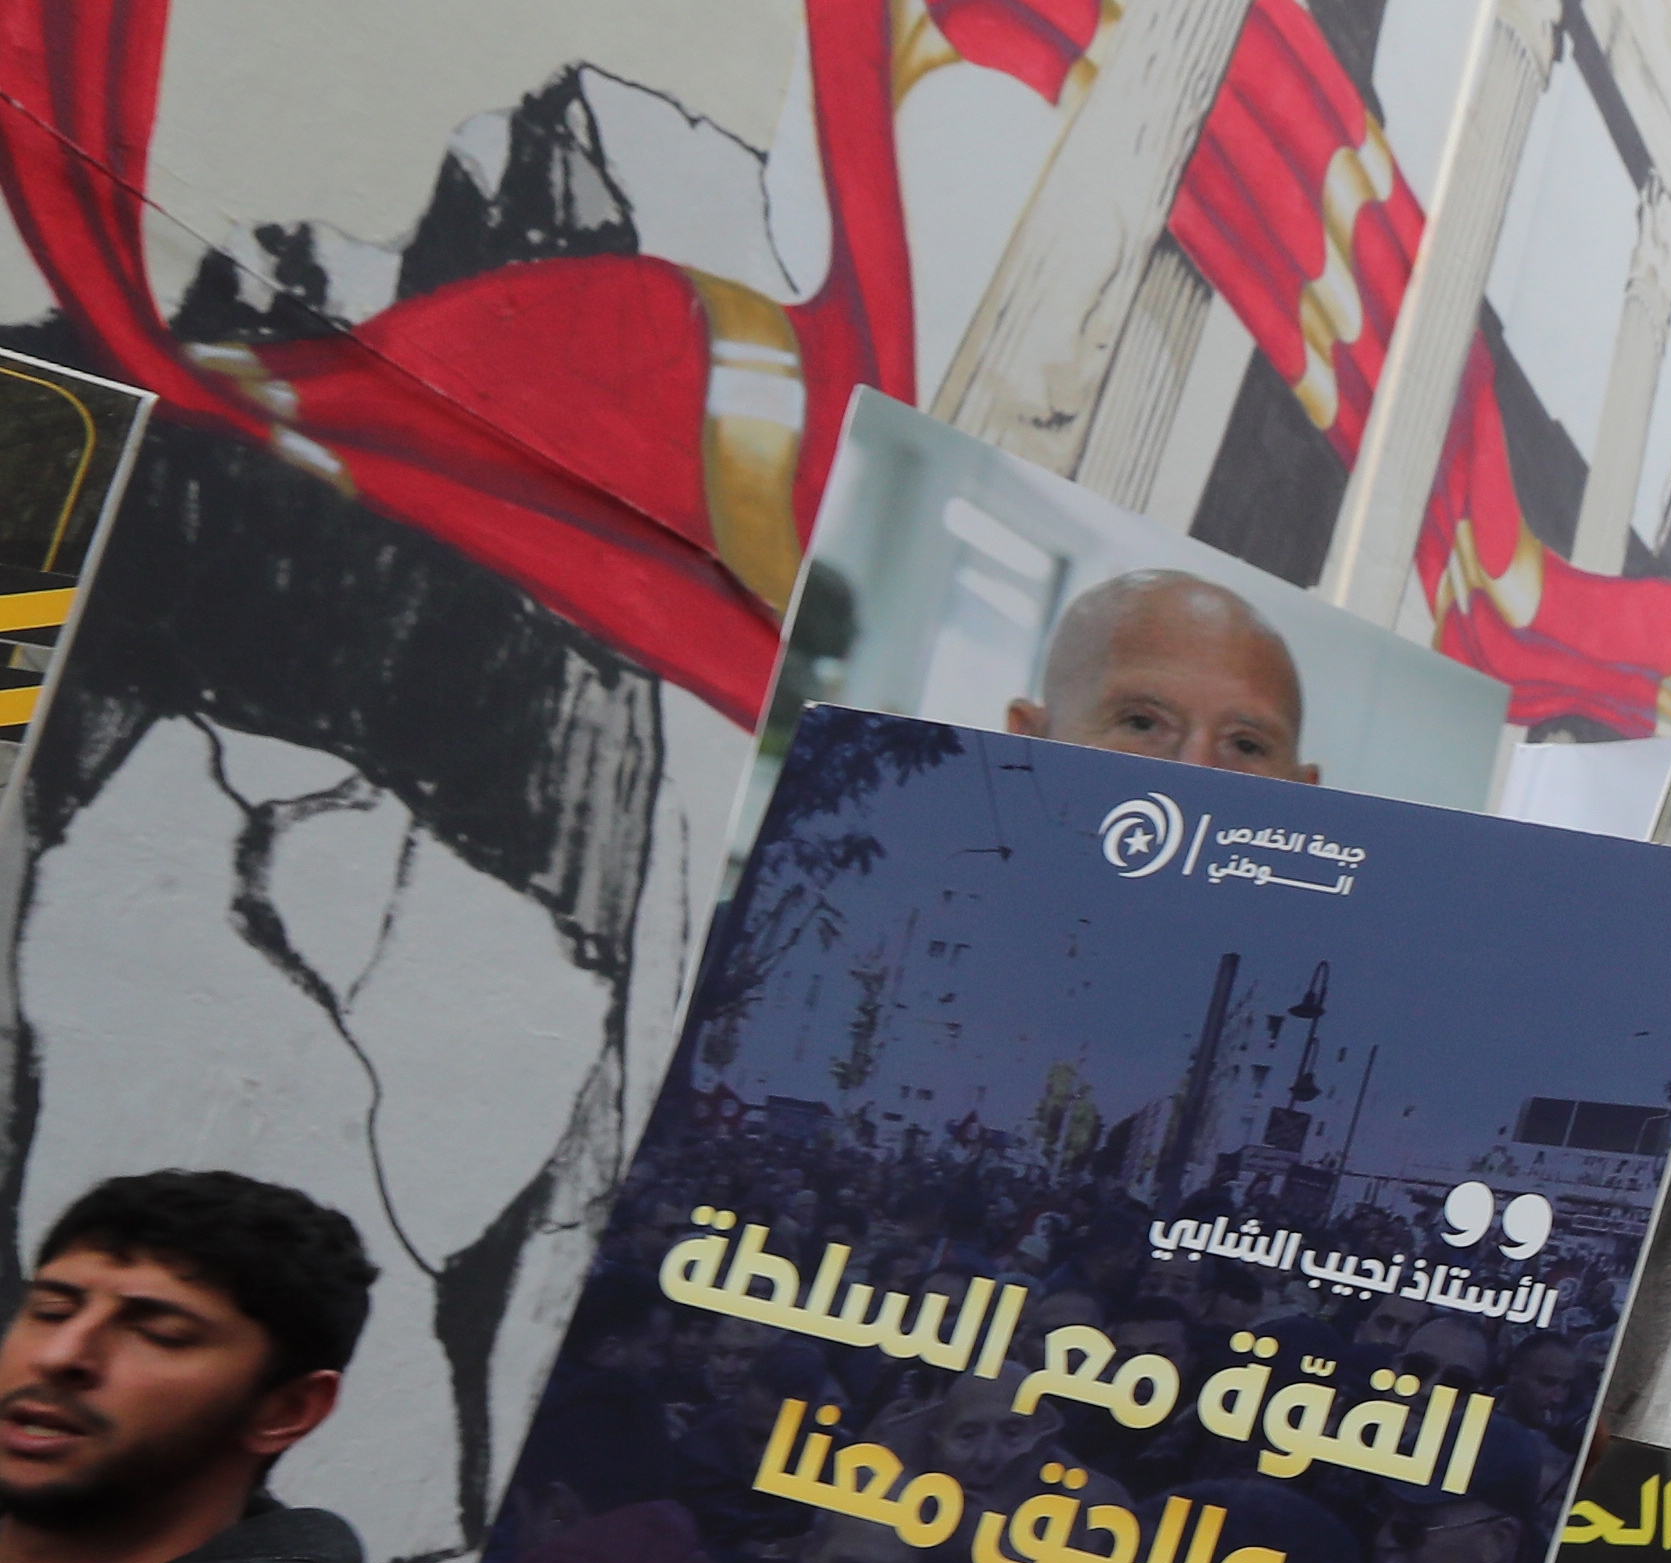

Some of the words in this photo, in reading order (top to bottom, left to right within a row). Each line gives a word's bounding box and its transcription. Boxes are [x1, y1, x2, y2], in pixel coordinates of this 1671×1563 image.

[1216, 826, 1307, 853] الخلاص
[1306, 834, 1367, 870] جبهة
[1148, 1215, 1302, 1272] الشابي
[1300, 1248, 1406, 1301] نجيب
[658, 1204, 1029, 1381] السلطة
[1399, 1258, 1560, 1329] الأستاذ
[1011, 1323, 1181, 1430] مع
[751, 1398, 965, 1550] معنا
